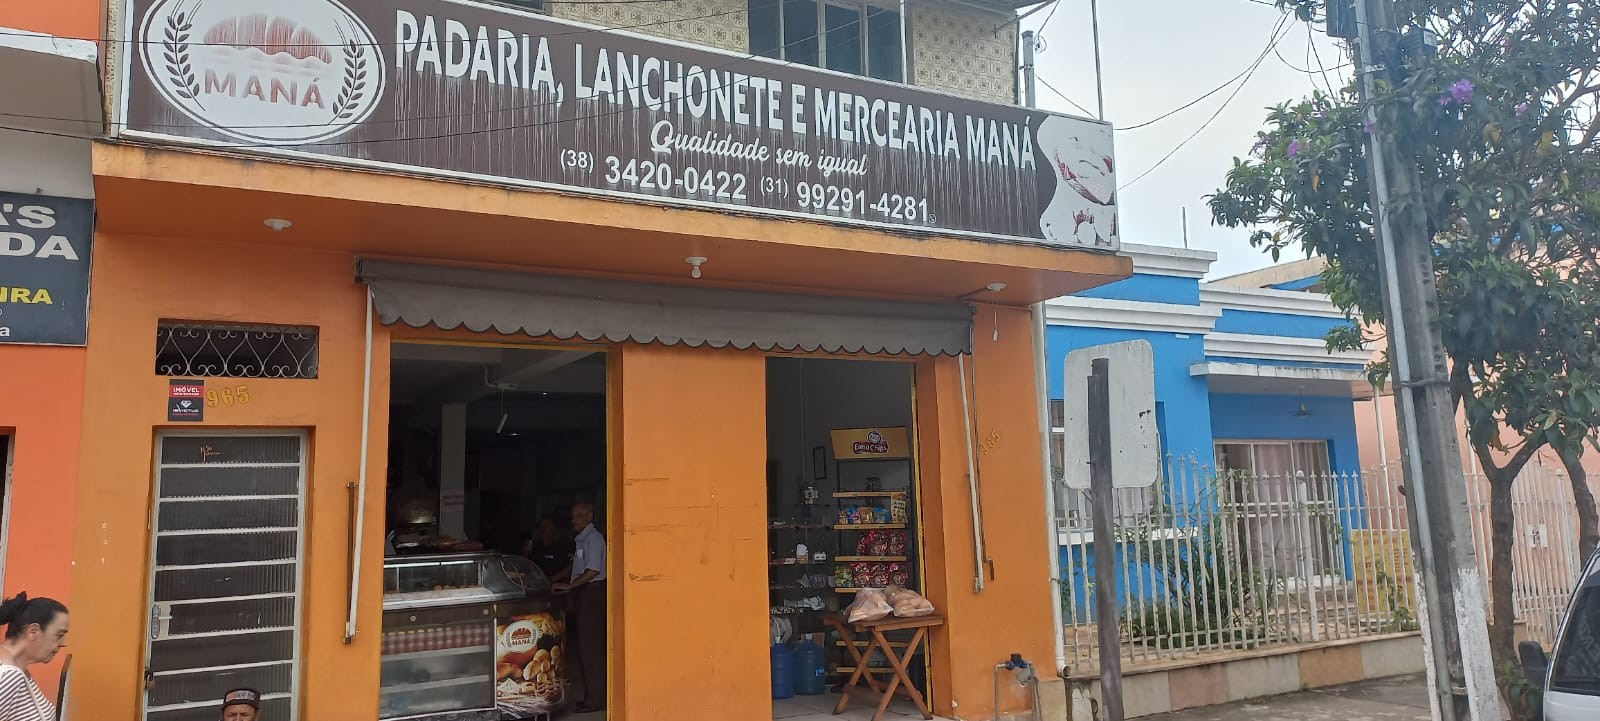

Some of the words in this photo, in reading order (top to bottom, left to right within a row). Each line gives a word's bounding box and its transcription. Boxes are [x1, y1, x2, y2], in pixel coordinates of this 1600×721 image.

[204, 68, 325, 109] MANÁ
[396, 9, 564, 107] PADARIA,
[575, 43, 783, 131] LANCHONETE
[791, 83, 807, 135] E
[814, 87, 960, 160] MERCEARIA
[966, 115, 1036, 171] MANÁ
[651, 119, 770, 162] Qualidade
[775, 147, 812, 169] sem
[817, 149, 868, 177] igual
[560, 148, 594, 174] (38)
[604, 155, 747, 201] 3420-0422
[760, 175, 789, 198] (31)
[796, 181, 928, 222] 99291-4281
[206, 384, 250, 408] 965
